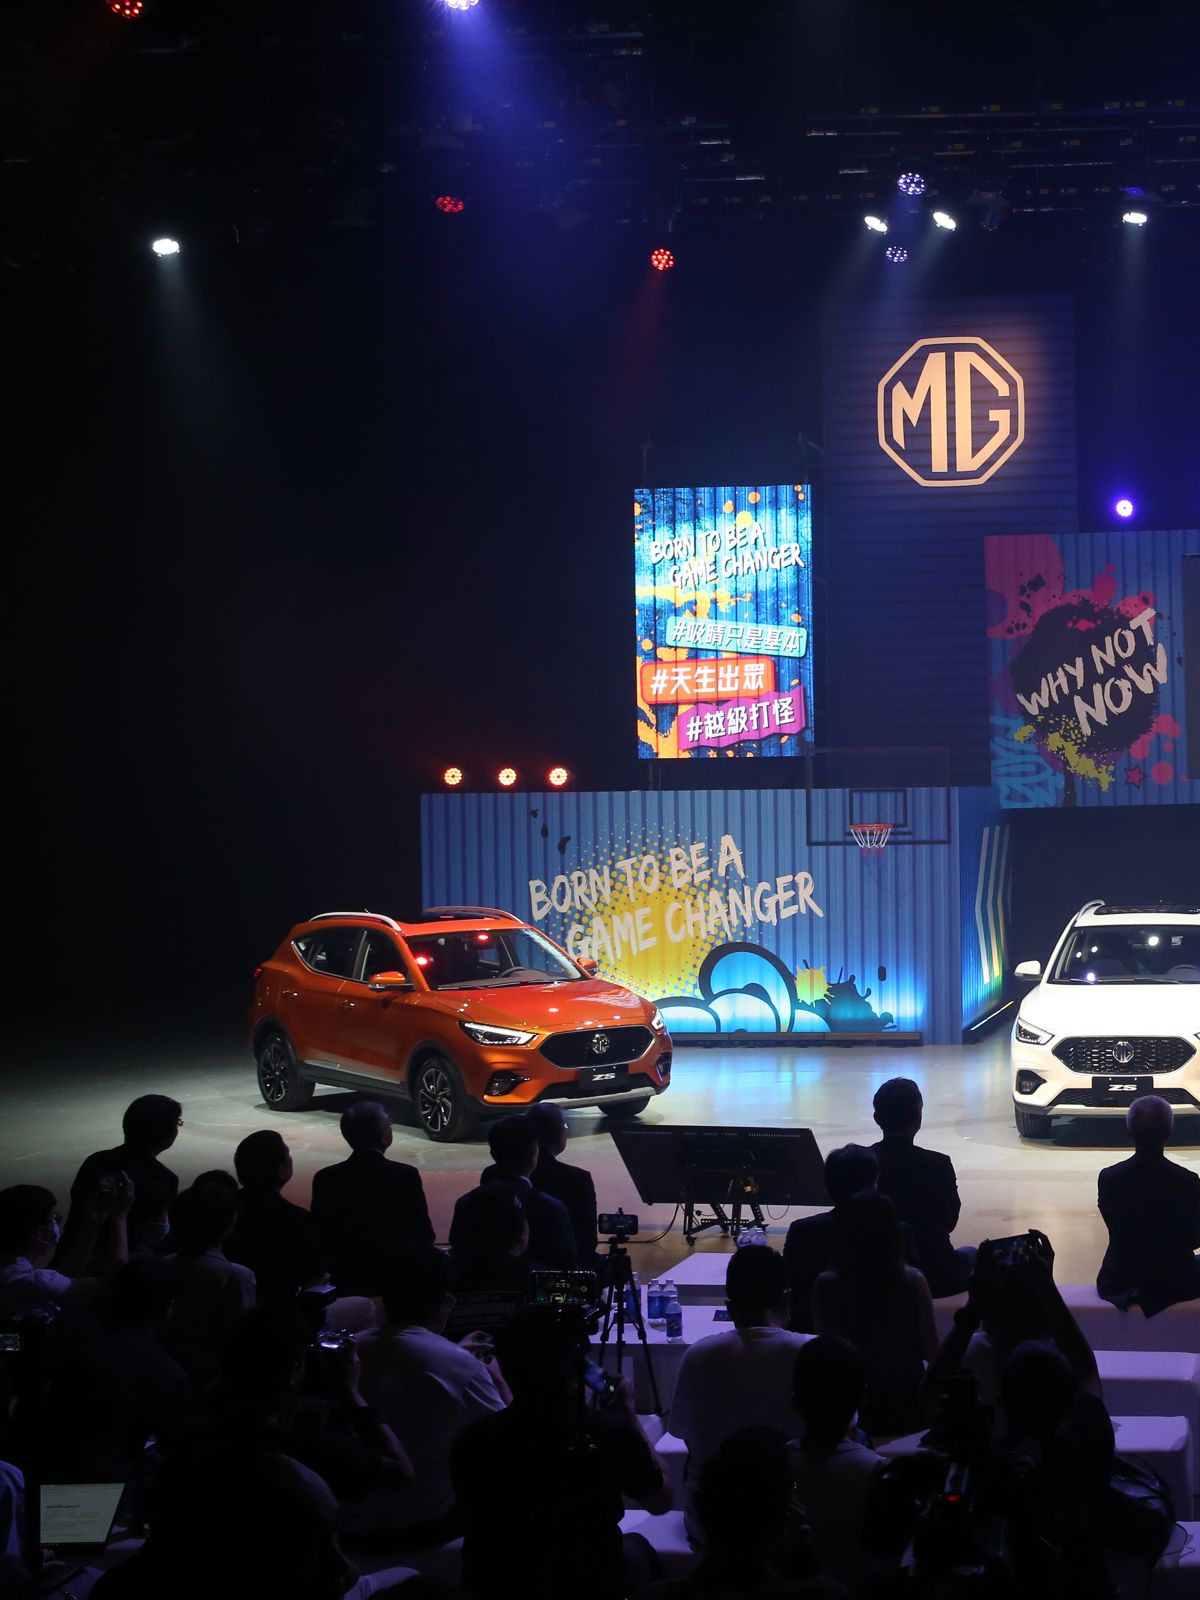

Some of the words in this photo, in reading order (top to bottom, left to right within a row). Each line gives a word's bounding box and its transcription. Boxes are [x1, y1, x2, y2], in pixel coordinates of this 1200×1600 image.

[892, 351, 1011, 472] MG
[651, 537, 695, 564] BORN
[697, 529, 722, 556] TO
[727, 523, 752, 551] BE
[751, 521, 767, 546] A
[668, 558, 719, 589] GAME
[722, 542, 806, 578] CHANGER
[650, 662, 766, 696] #天生出眾
[1016, 656, 1084, 716] WHY
[1091, 607, 1157, 675] NOT
[1073, 643, 1169, 737] NOW
[685, 695, 796, 742] #越級打怪
[529, 865, 611, 922] BORN
[616, 854, 660, 899] TO
[669, 842, 713, 890] BE
[717, 833, 746, 880] A
[566, 907, 657, 965] GAME
[665, 871, 825, 943] CHANGER
[592, 1072, 616, 1081] ZS
